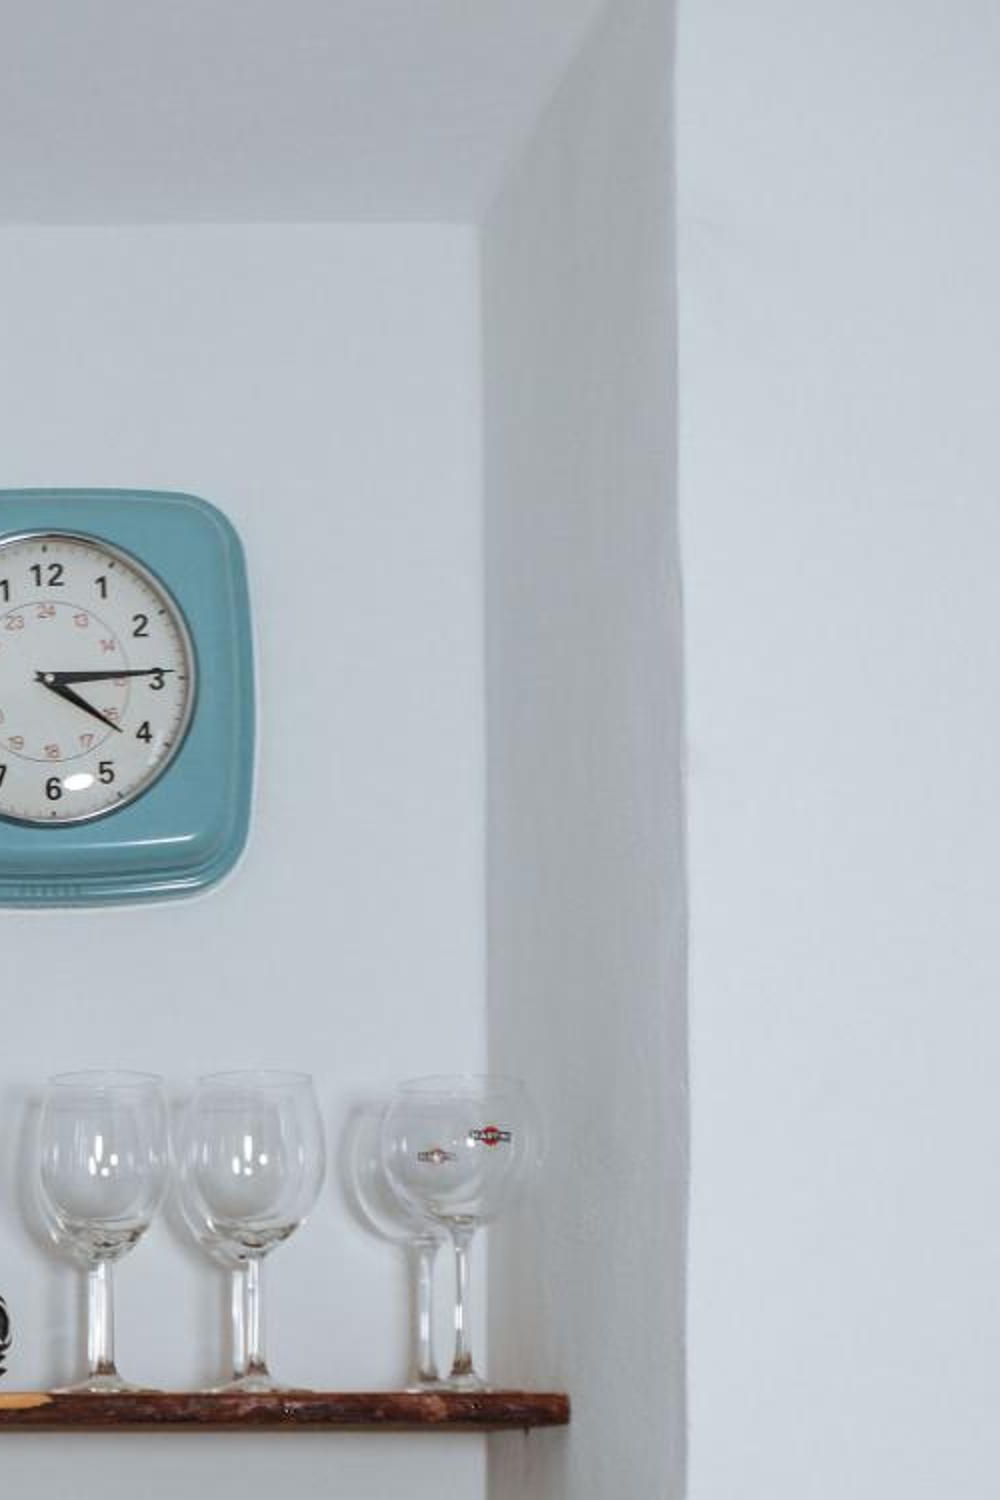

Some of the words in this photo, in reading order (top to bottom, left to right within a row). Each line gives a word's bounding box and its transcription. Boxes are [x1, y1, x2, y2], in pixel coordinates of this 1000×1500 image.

[30, 563, 65, 587] 12
[96, 576, 108, 599] 1
[36, 603, 56, 619] 24
[5, 615, 26, 631] 23
[73, 614, 89, 629] 13
[132, 613, 149, 638] 2
[100, 639, 117, 653] 14
[149, 668, 166, 691] 3
[136, 720, 153, 744] 4
[8, 735, 25, 751] 19
[79, 734, 95, 750] 17
[44, 744, 61, 760] 18
[99, 761, 116, 785] 5
[45, 776, 63, 801] 6
